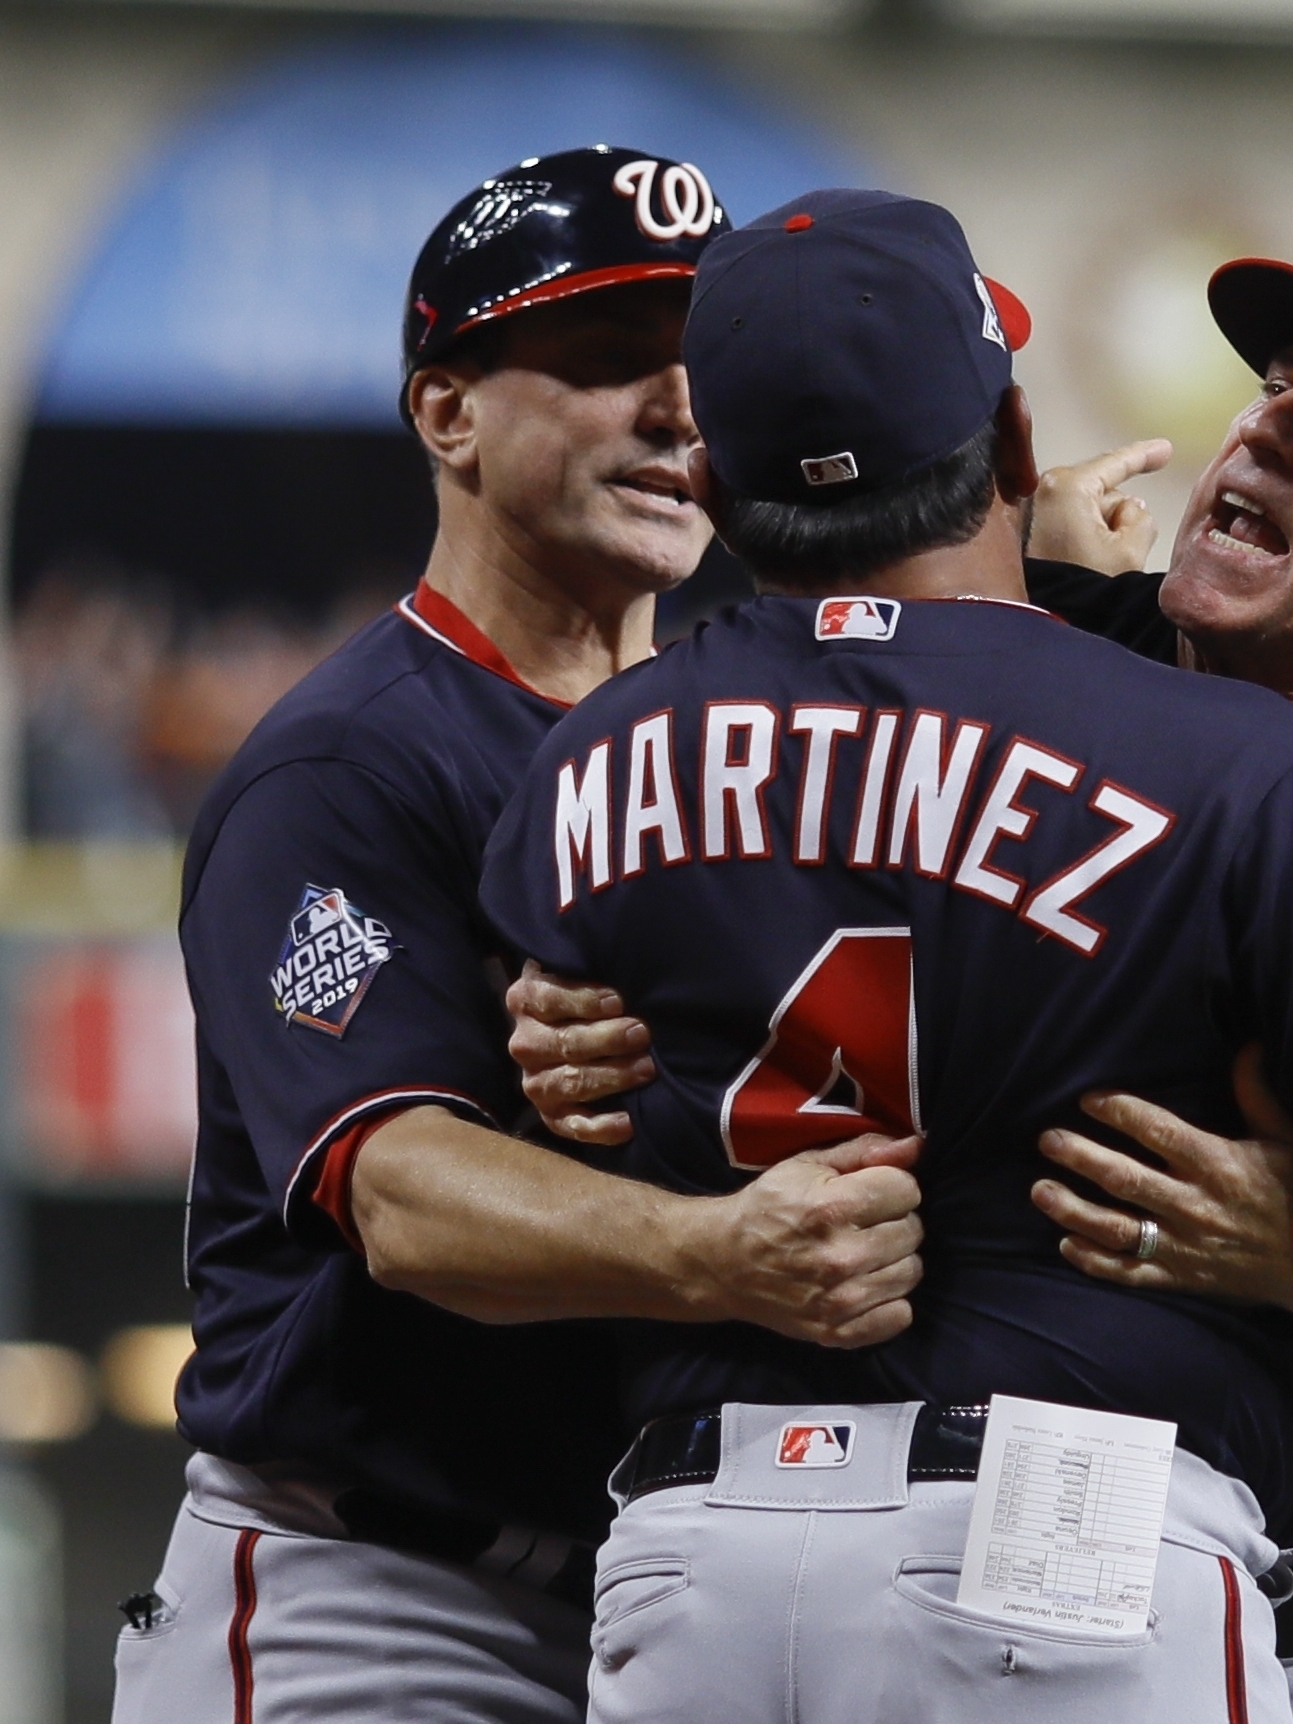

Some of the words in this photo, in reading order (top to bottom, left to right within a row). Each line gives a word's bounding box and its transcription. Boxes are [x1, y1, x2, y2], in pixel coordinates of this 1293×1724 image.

[611, 160, 714, 242] W
[555, 699, 1175, 956] MARTINEZ
[271, 918, 392, 997] WORLD
[282, 939, 390, 1022] SERIES
[311, 977, 358, 1016] 2019
[721, 926, 926, 1171] 4
[1054, 1544, 1096, 1556] RELIEVERS
[1003, 1601, 1052, 1618] Verlander)
[1054, 1610, 1084, 1623] Justin
[1086, 1615, 1124, 1629] (Starter:
